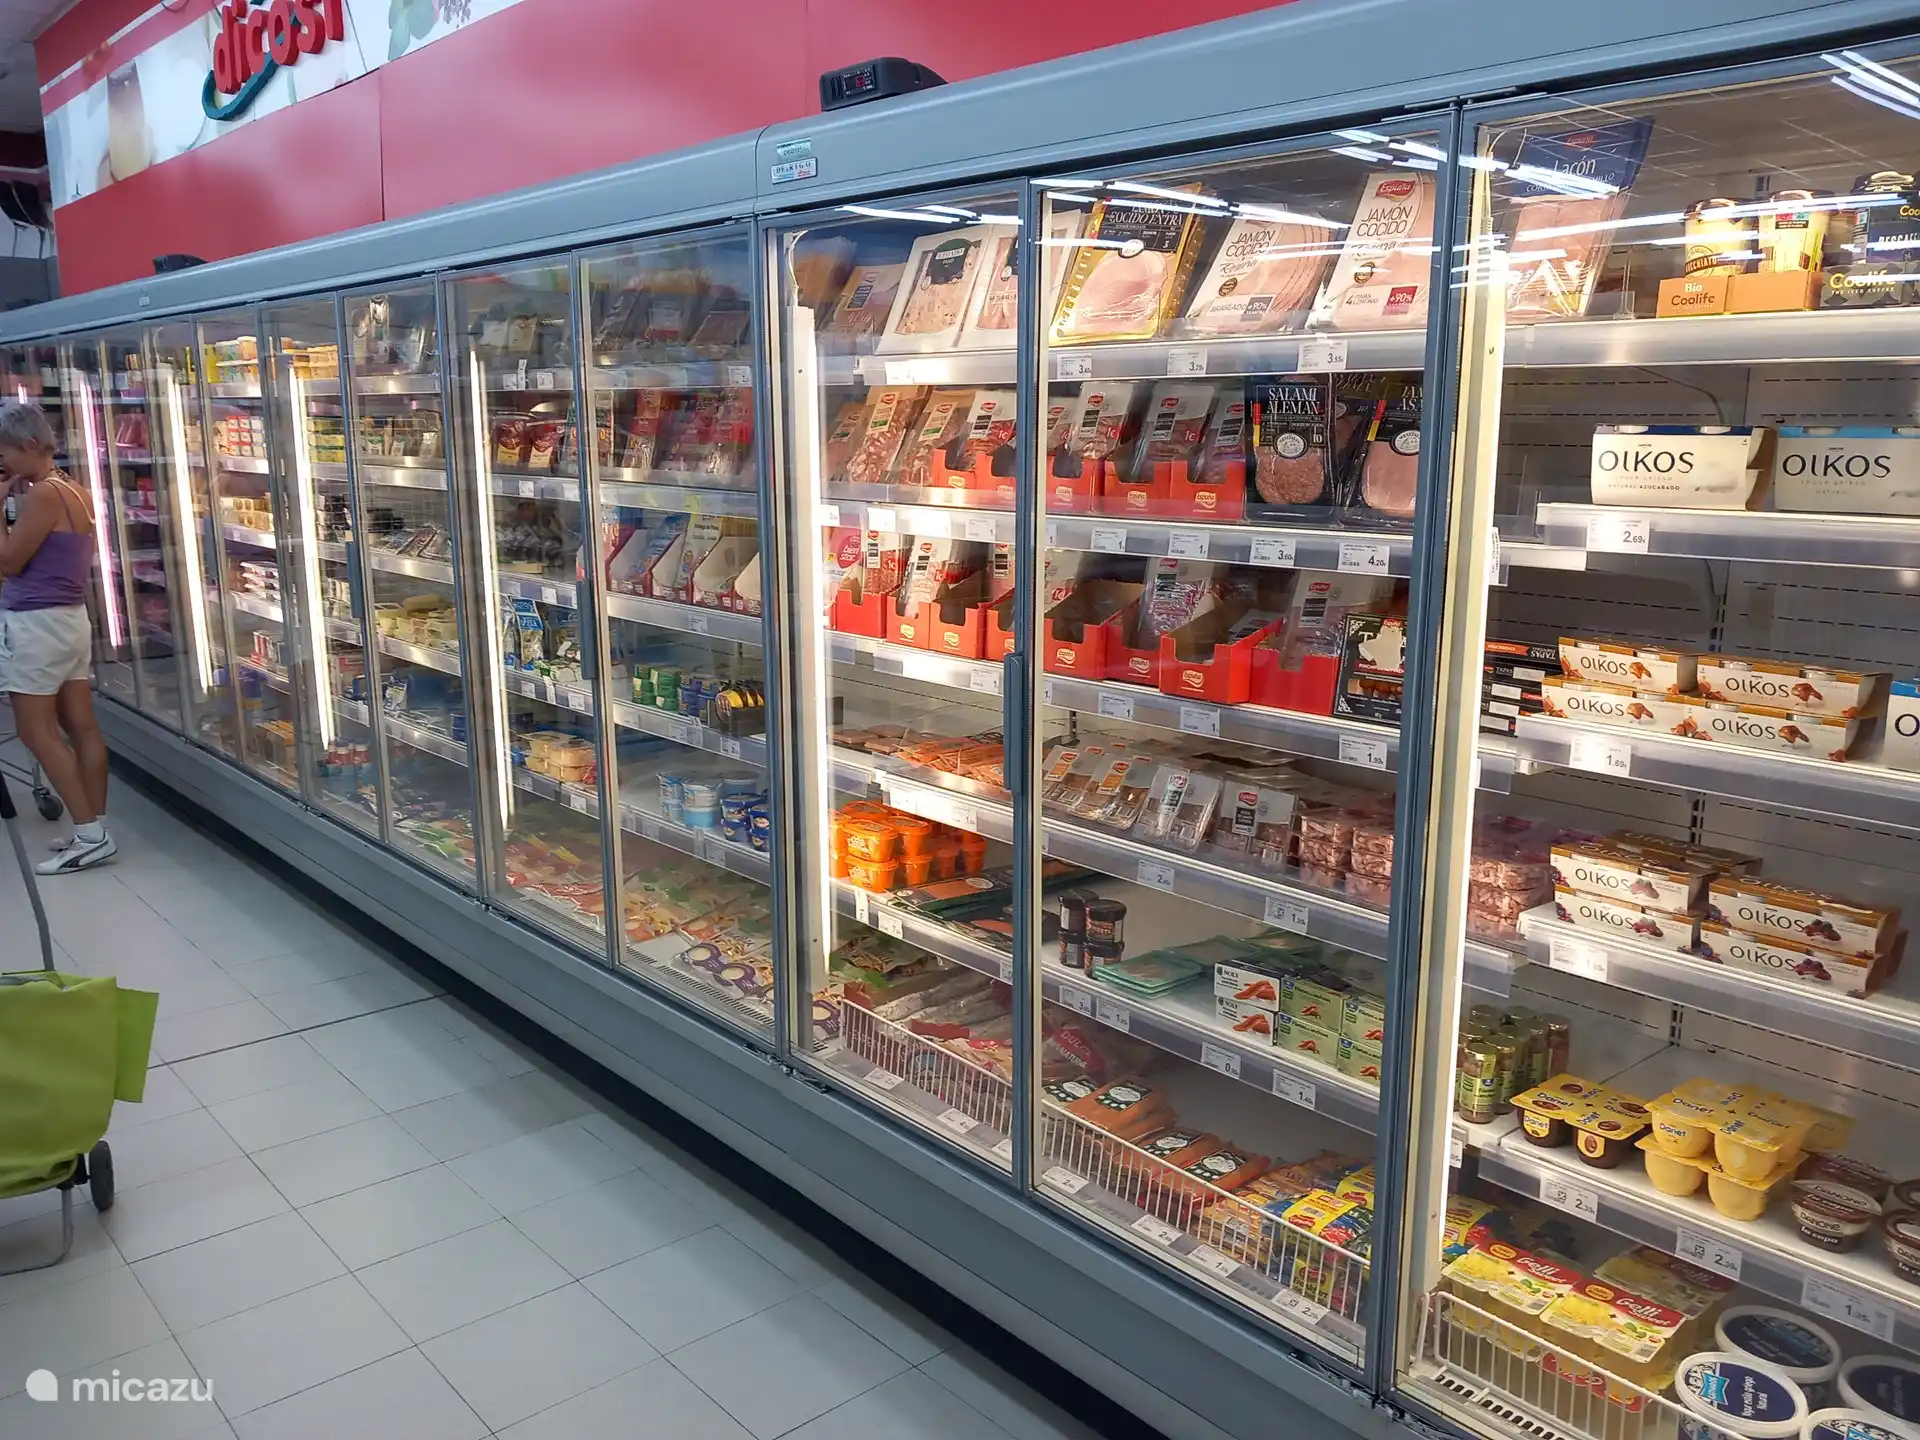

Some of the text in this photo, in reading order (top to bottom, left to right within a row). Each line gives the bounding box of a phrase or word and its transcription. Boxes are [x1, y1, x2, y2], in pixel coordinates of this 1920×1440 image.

[1361, 202, 1413, 223] JAMÓN
[1230, 227, 1276, 245] JAMÓN
[1356, 219, 1408, 238] COCIDO
[1684, 281, 1703, 293] Bio
[1345, 295, 1355, 305] 4
[1268, 387, 1318, 401] SALAMI
[1598, 450, 1695, 474] OIKOS
[1782, 453, 1892, 479] OIKOS
[1529, 650, 1557, 662] TAPAS
[1580, 655, 1629, 677] OIKOS
[1725, 677, 1790, 699] OIKOS
[1567, 696, 1625, 718] OIKOS
[1711, 717, 1777, 741] OIKOS
[1894, 713, 1920, 737] O
[1575, 867, 1630, 892] OIKOS
[1579, 905, 1635, 930] OIKOS
[1738, 907, 1806, 933] OIKOS
[1729, 945, 1796, 972] OIKOS
[1536, 1091, 1575, 1108] Danet
[1672, 1097, 1716, 1114] Danet
[1524, 1114, 1549, 1129] Danet
[1660, 1122, 1687, 1137] Danet
